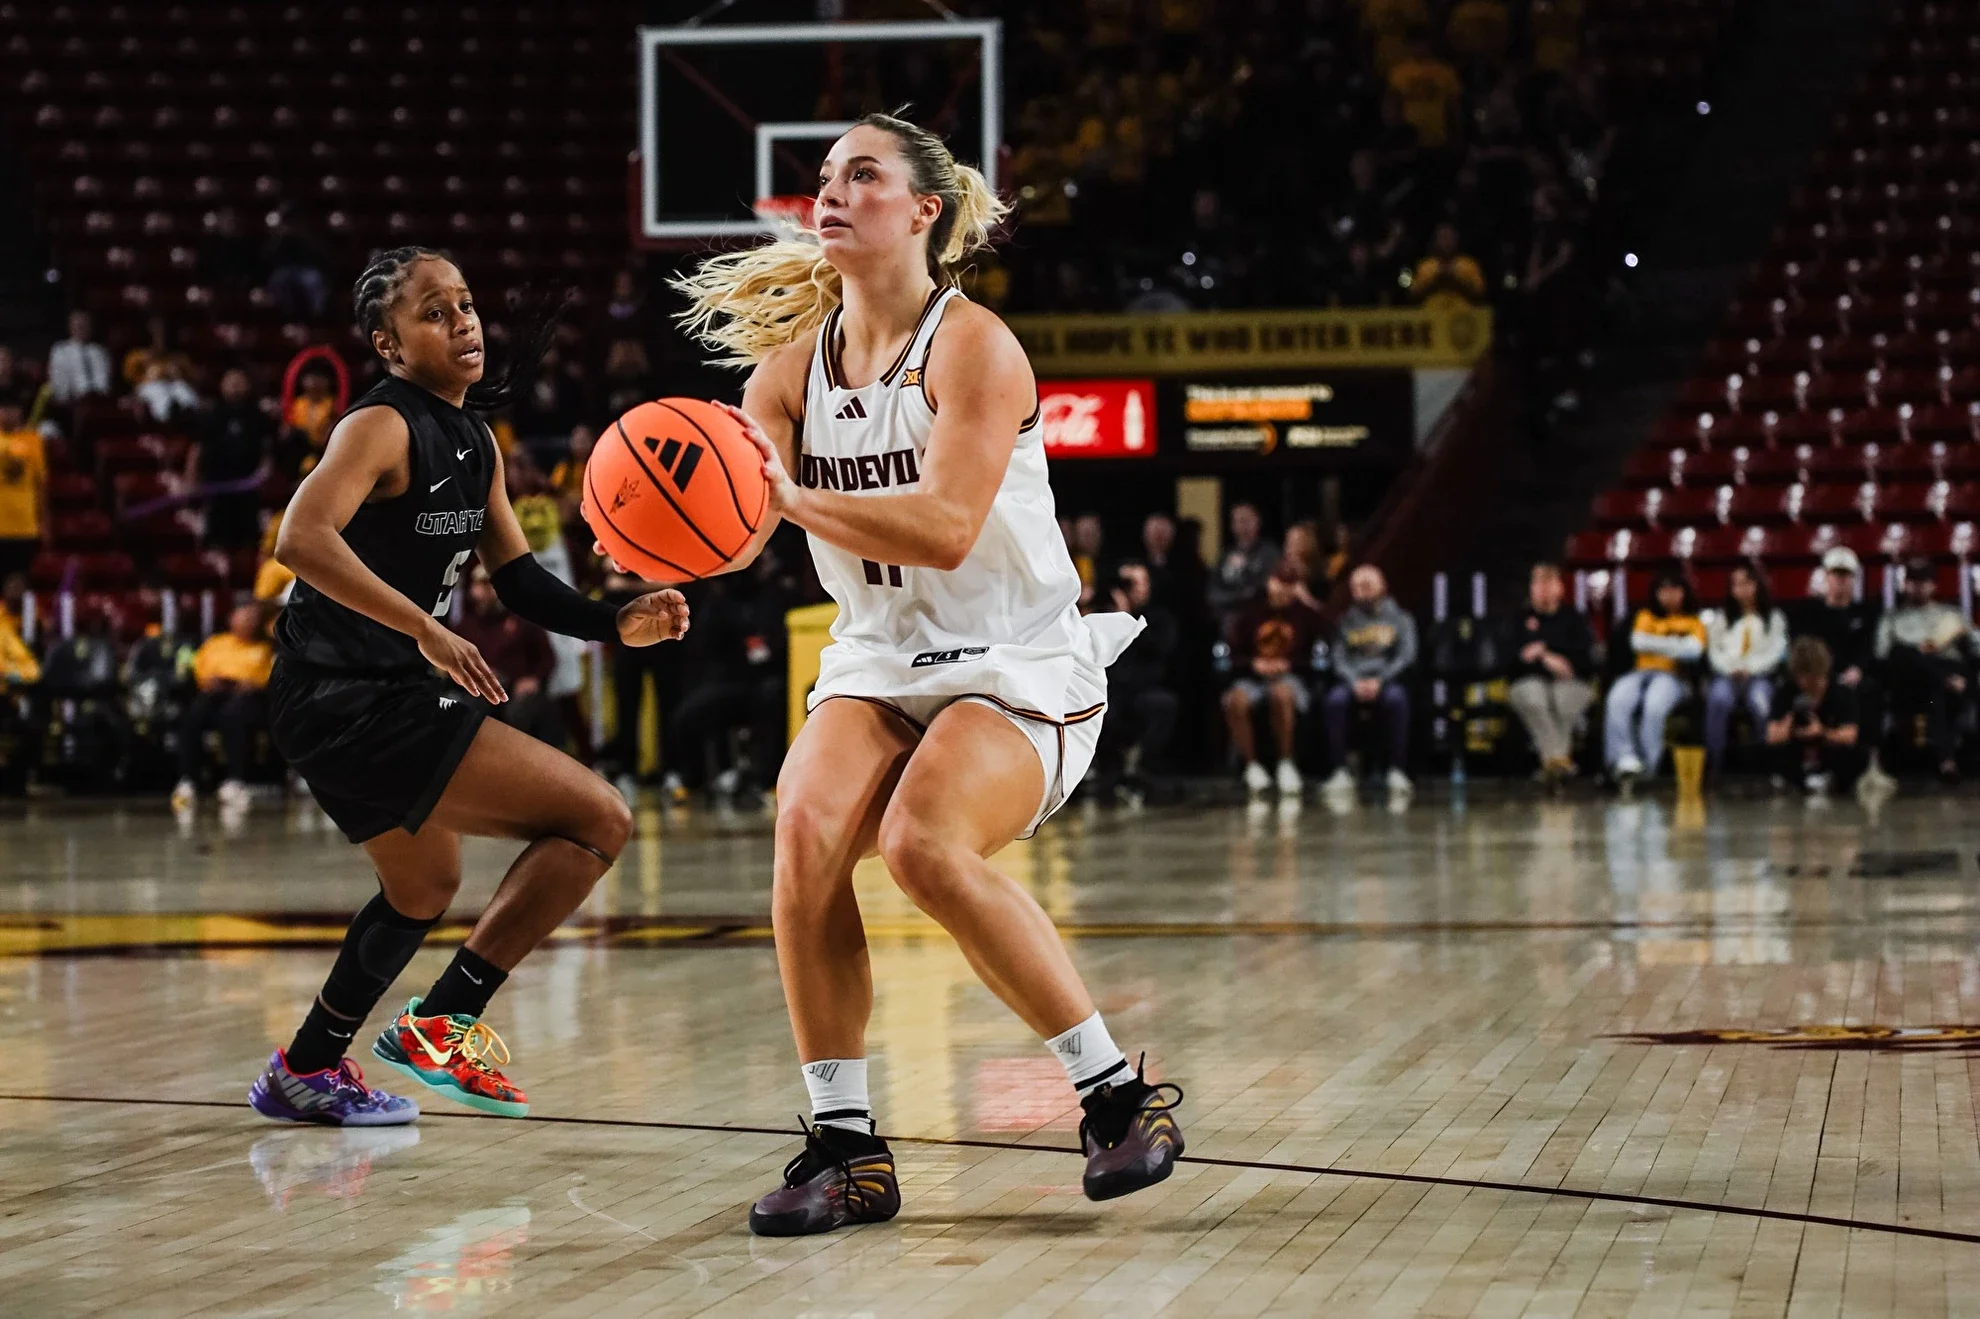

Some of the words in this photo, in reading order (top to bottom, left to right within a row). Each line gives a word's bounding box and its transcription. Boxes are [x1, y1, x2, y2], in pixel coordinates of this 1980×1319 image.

[1187, 324, 1249, 352] WHO
[1259, 322, 1351, 350] ENTER
[1359, 320, 1432, 349] HERE
[795, 447, 925, 491] UNDEVIL
